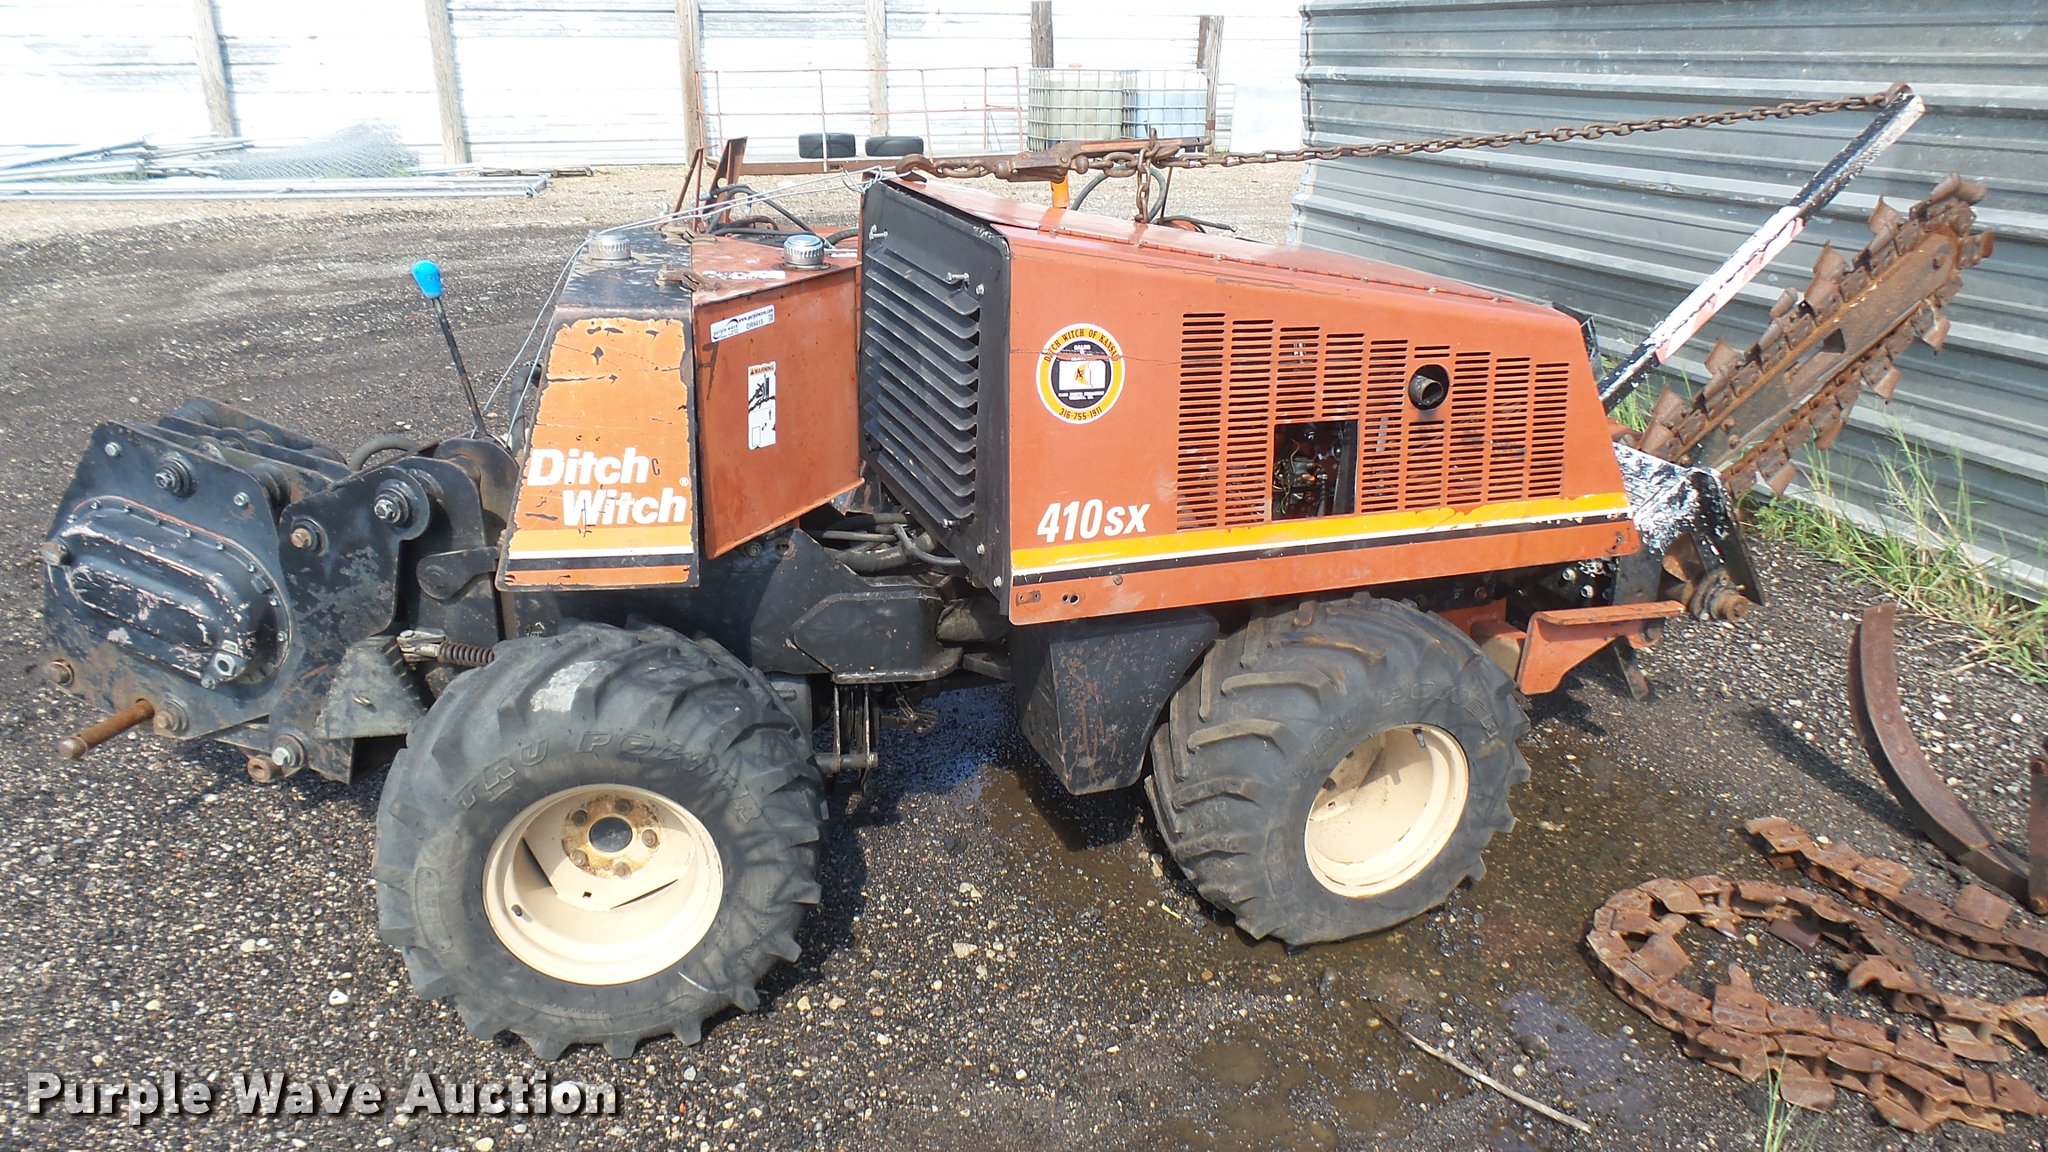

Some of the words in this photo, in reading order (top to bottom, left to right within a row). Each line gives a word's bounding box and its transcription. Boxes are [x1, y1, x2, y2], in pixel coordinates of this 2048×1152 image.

[1062, 328, 1085, 342] WITCH
[1088, 329, 1098, 339] OF
[1099, 334, 1121, 361] KANSA
[527, 447, 650, 487] Ditch
[562, 487, 687, 526] Witch
